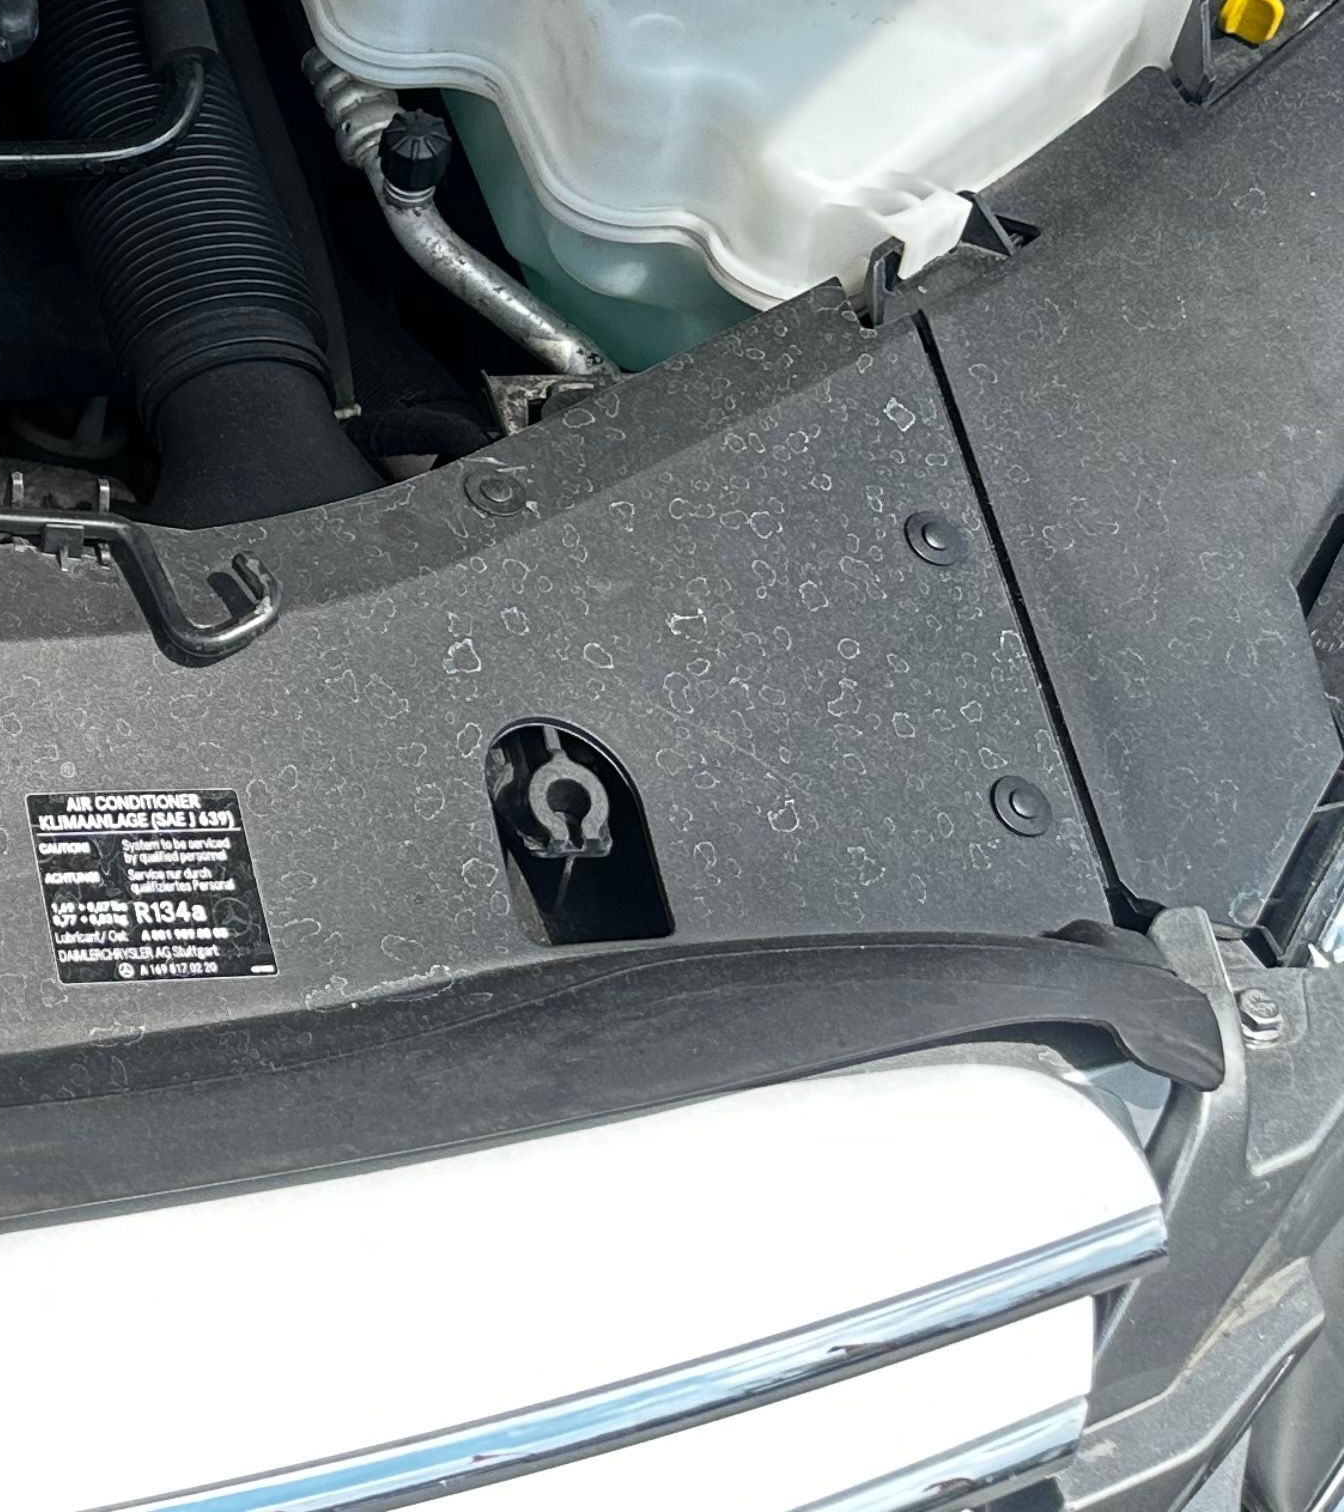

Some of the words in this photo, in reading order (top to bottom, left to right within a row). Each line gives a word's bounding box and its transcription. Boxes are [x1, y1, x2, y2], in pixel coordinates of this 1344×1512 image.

[65, 796, 94, 811] AIR
[94, 793, 201, 810] CONDITIONER
[38, 812, 148, 830] KLIMAANLAGE
[150, 811, 187, 830] (SAE
[187, 811, 196, 826] J
[197, 810, 235, 828] 639)
[121, 838, 160, 852] System
[161, 838, 172, 850] to
[173, 838, 186, 849] be
[187, 835, 231, 849] serviced
[123, 852, 138, 864] by
[127, 868, 165, 881] Service
[166, 868, 183, 879] nur
[183, 866, 212, 879] durch
[192, 877, 236, 891] Personal
[133, 899, 208, 924] R134a
[141, 930, 150, 941] A
[58, 946, 153, 962] DAIMLERCHRYSLER
[172, 943, 220, 960] Stuttgart
[140, 964, 148, 975] A
[150, 963, 167, 975] 169
[189, 961, 203, 972] 02
[204, 960, 218, 971] 20
